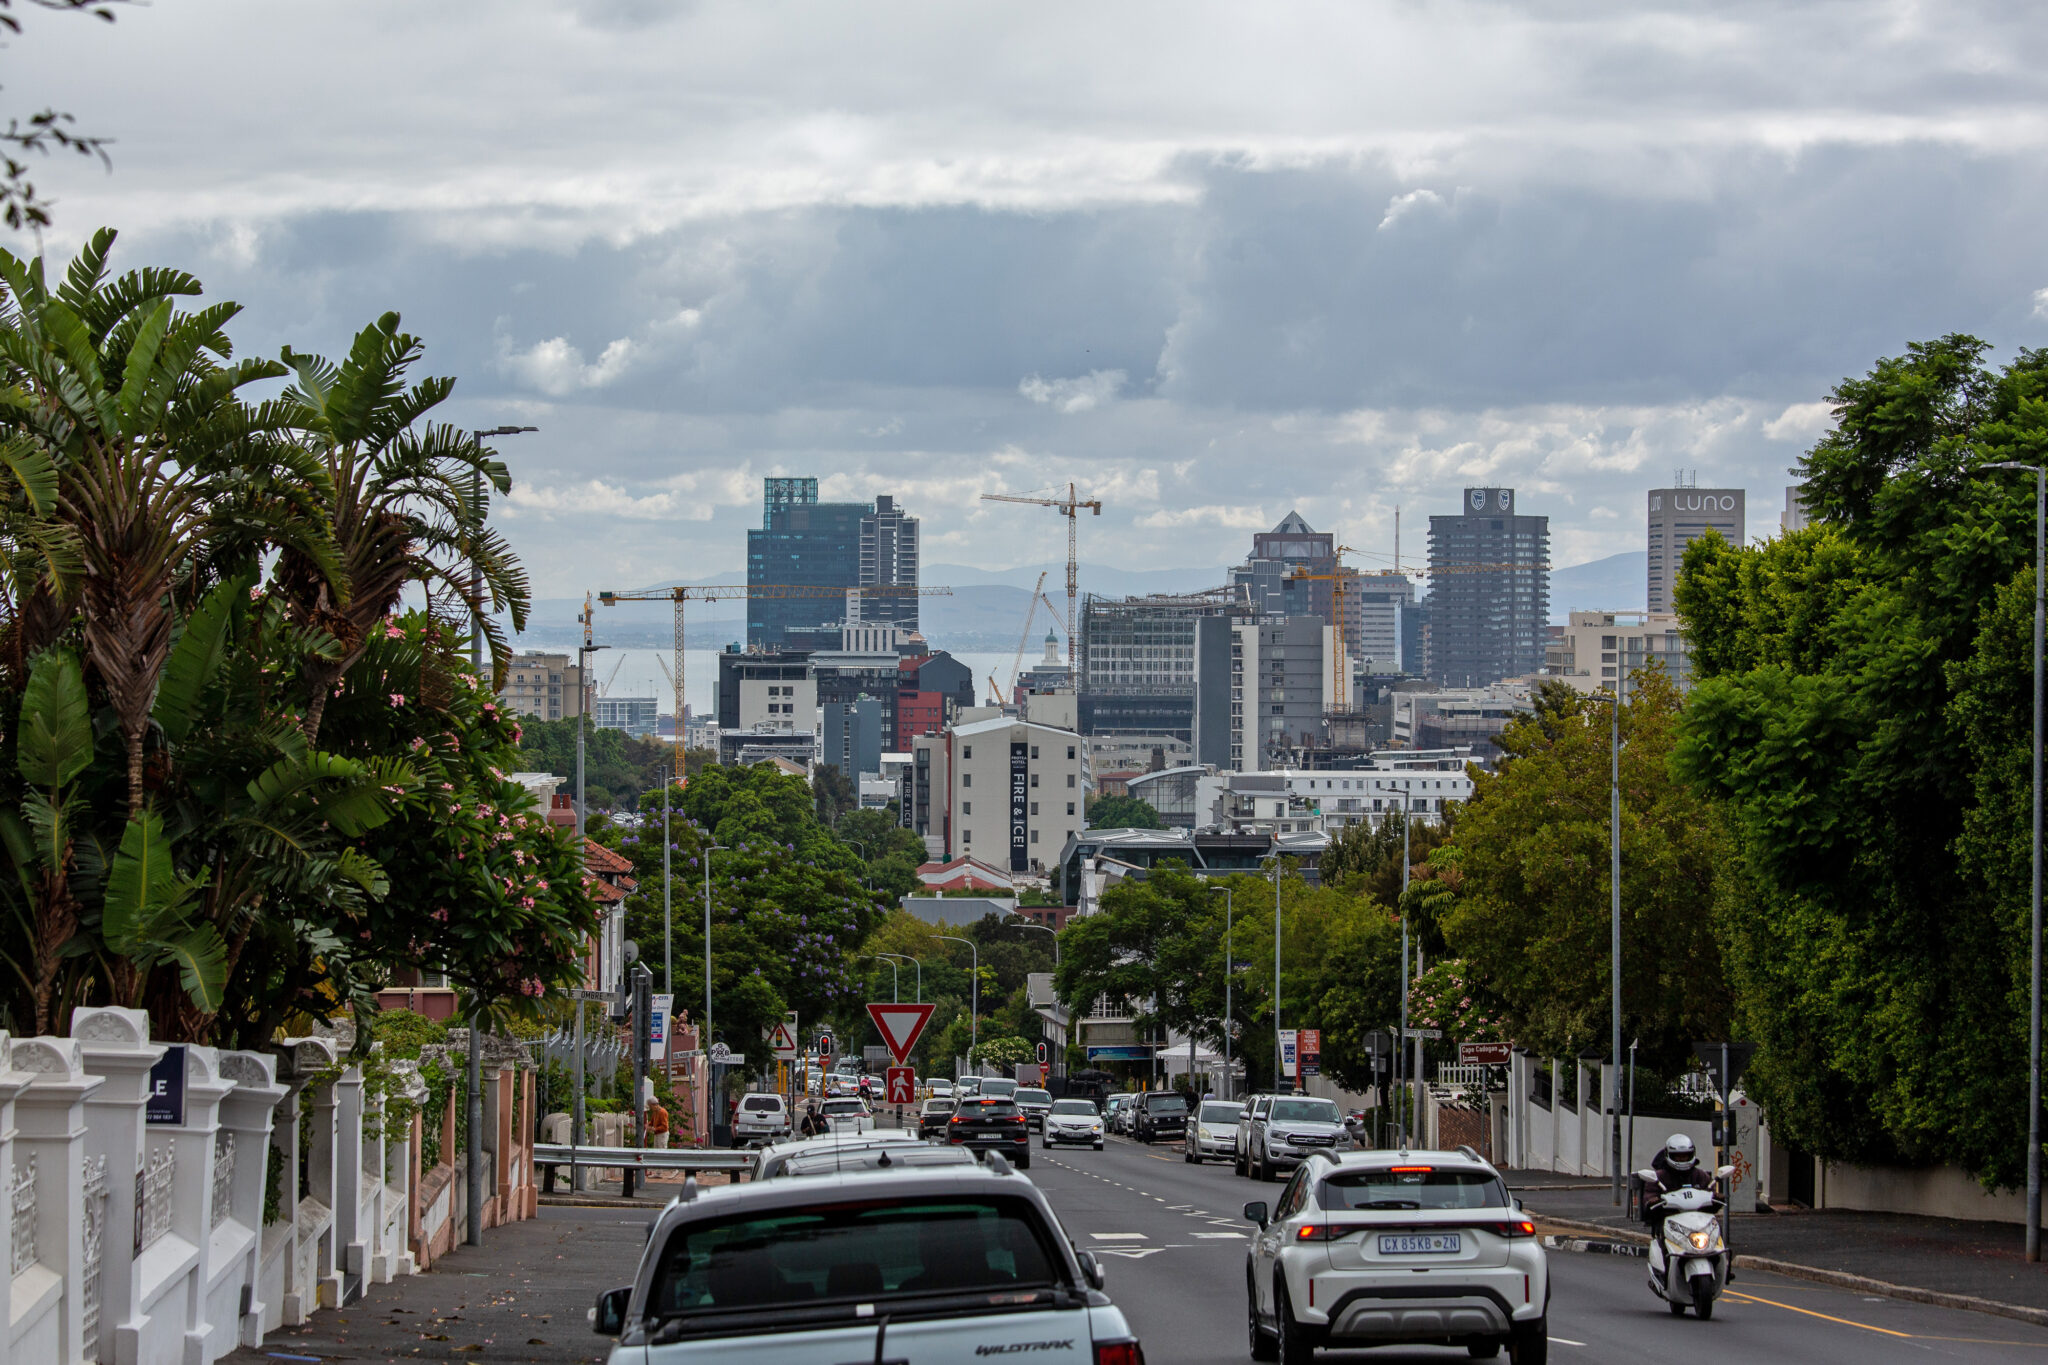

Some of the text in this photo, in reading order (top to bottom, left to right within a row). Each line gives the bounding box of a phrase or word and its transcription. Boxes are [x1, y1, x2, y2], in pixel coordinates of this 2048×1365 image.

[1674, 495, 1735, 511] LUNO
[904, 781, 912, 799] FIRE
[1013, 773, 1025, 803] FIRE
[1013, 807, 1023, 816] &
[1013, 820, 1025, 848] ICE!
[581, 990, 603, 1000] OMBRE
[1461, 1045, 1475, 1054] Cape
[1683, 1190, 1693, 1200] 18
[1443, 1236, 1457, 1249] ZN
[975, 1338, 1075, 1357] WILDTRAK
